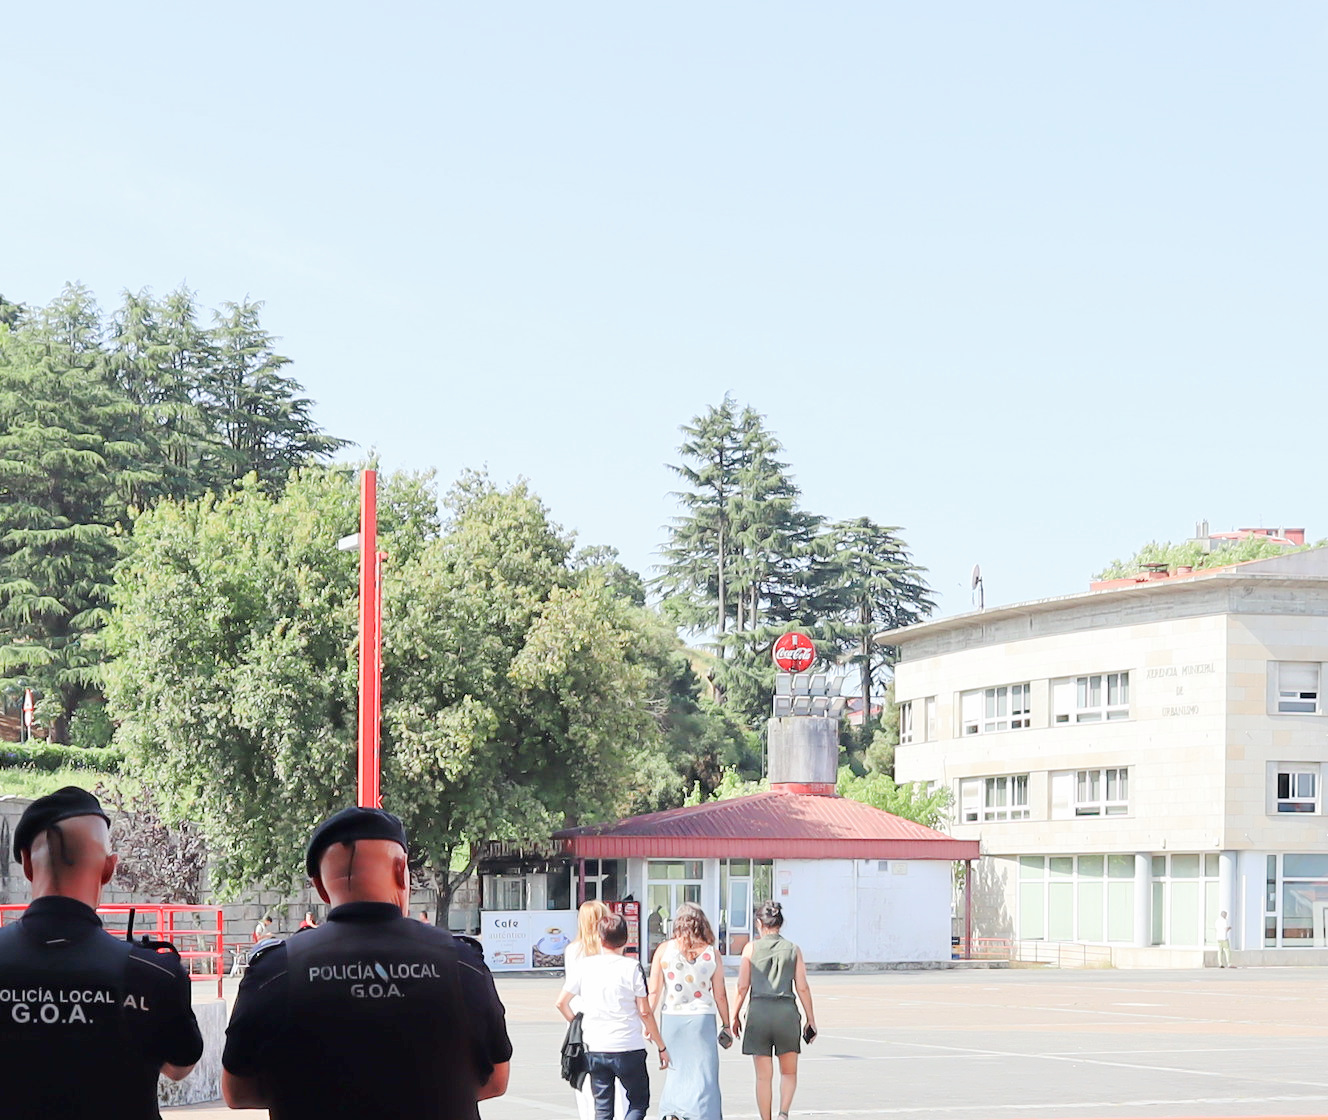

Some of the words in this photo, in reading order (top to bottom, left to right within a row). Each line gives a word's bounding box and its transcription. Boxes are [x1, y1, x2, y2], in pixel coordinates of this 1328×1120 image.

[309, 961, 375, 982] POLICÍA
[389, 963, 441, 979] LOCAL
[59, 990, 115, 1004] LOCAL
[350, 983, 405, 998] G.O.A.
[11, 1003, 94, 1024] G.O.A.
